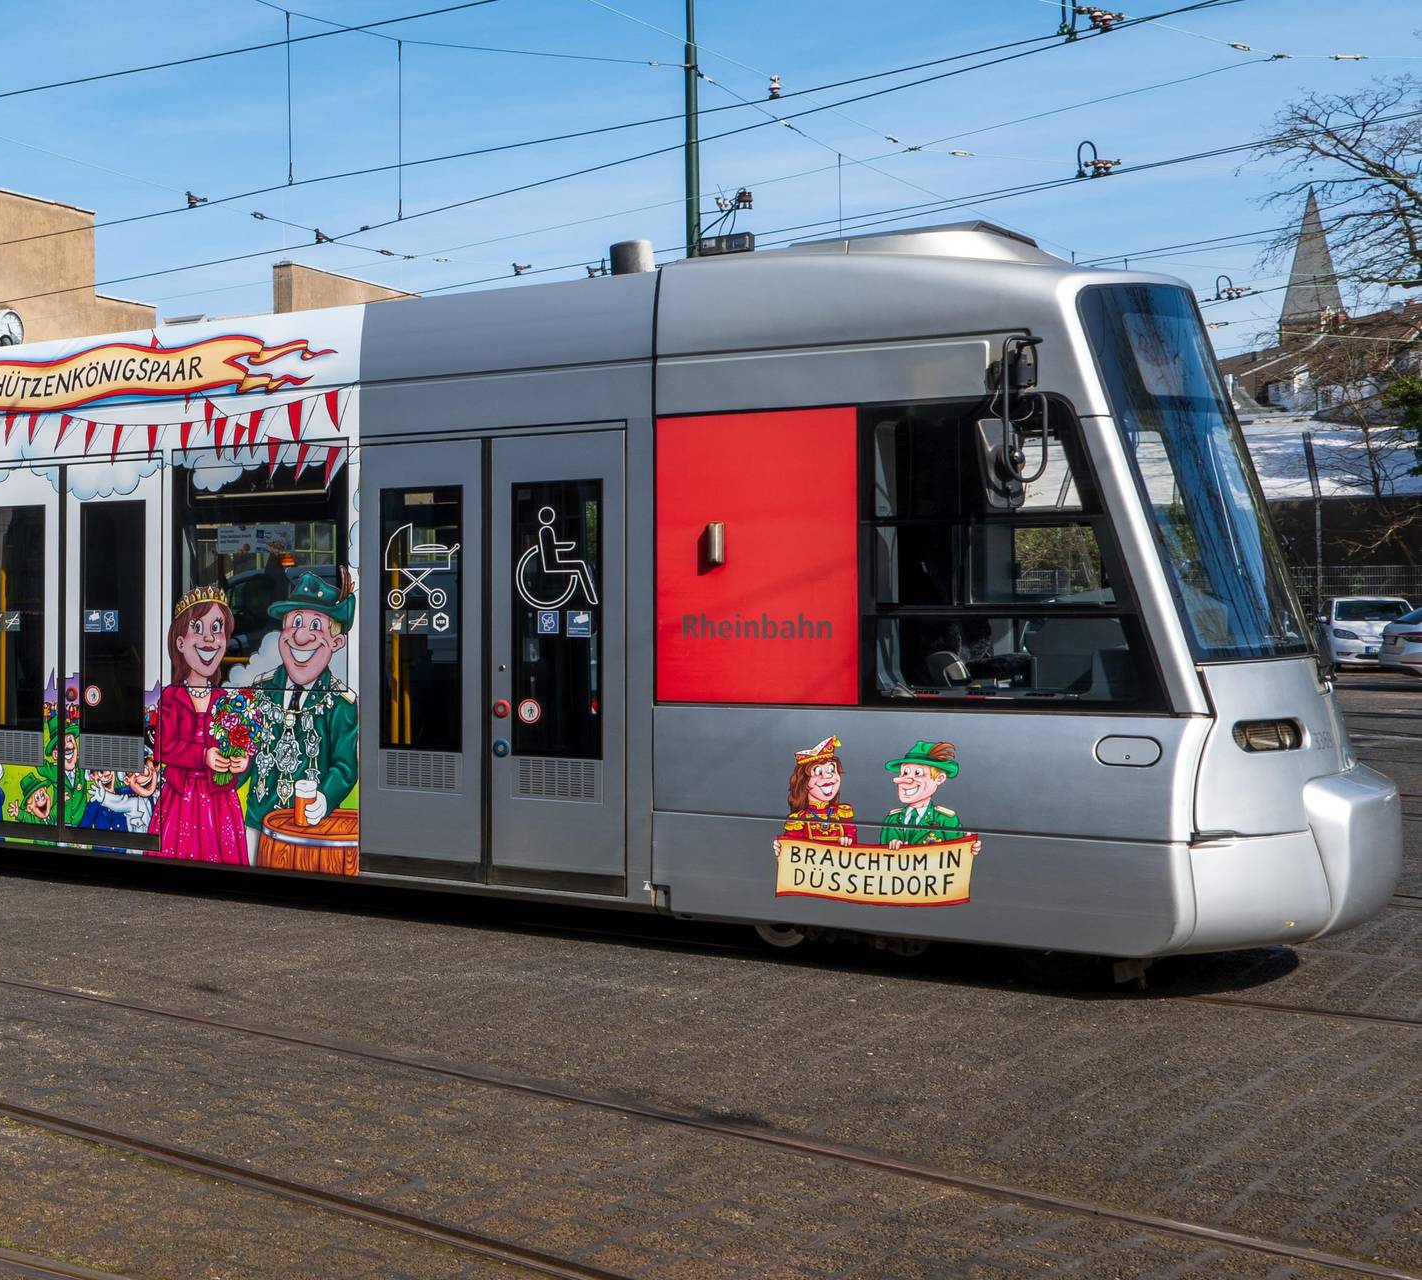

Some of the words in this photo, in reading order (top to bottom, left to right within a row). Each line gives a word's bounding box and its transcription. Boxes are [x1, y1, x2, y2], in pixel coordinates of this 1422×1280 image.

[681, 612, 834, 640] Rheinbahn
[790, 845, 928, 872] BRAUCHTUM
[938, 848, 962, 869] IN
[793, 867, 955, 897] DÜSSELDORF
